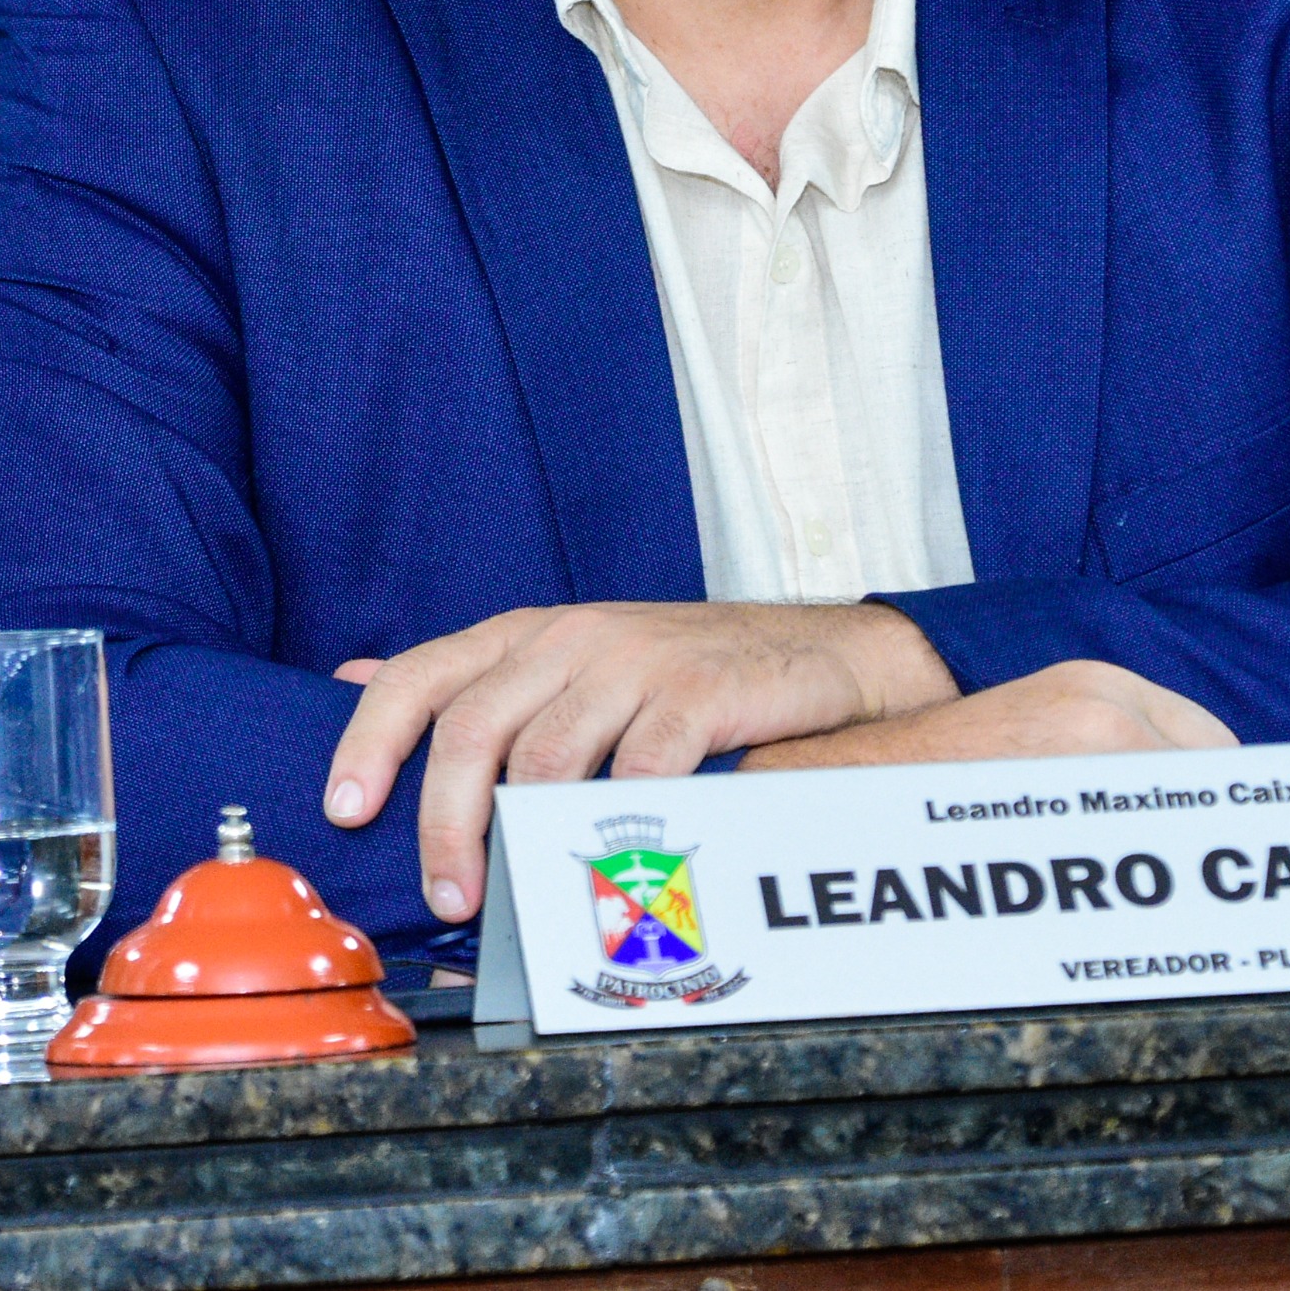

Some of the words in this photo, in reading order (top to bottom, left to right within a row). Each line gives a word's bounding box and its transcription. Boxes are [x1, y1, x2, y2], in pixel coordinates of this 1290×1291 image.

[926, 795, 1071, 823] Leandro
[1080, 785, 1220, 814] Maximo
[758, 851, 1175, 930] LEANDRO
[1060, 951, 1233, 982] VEREADOR
